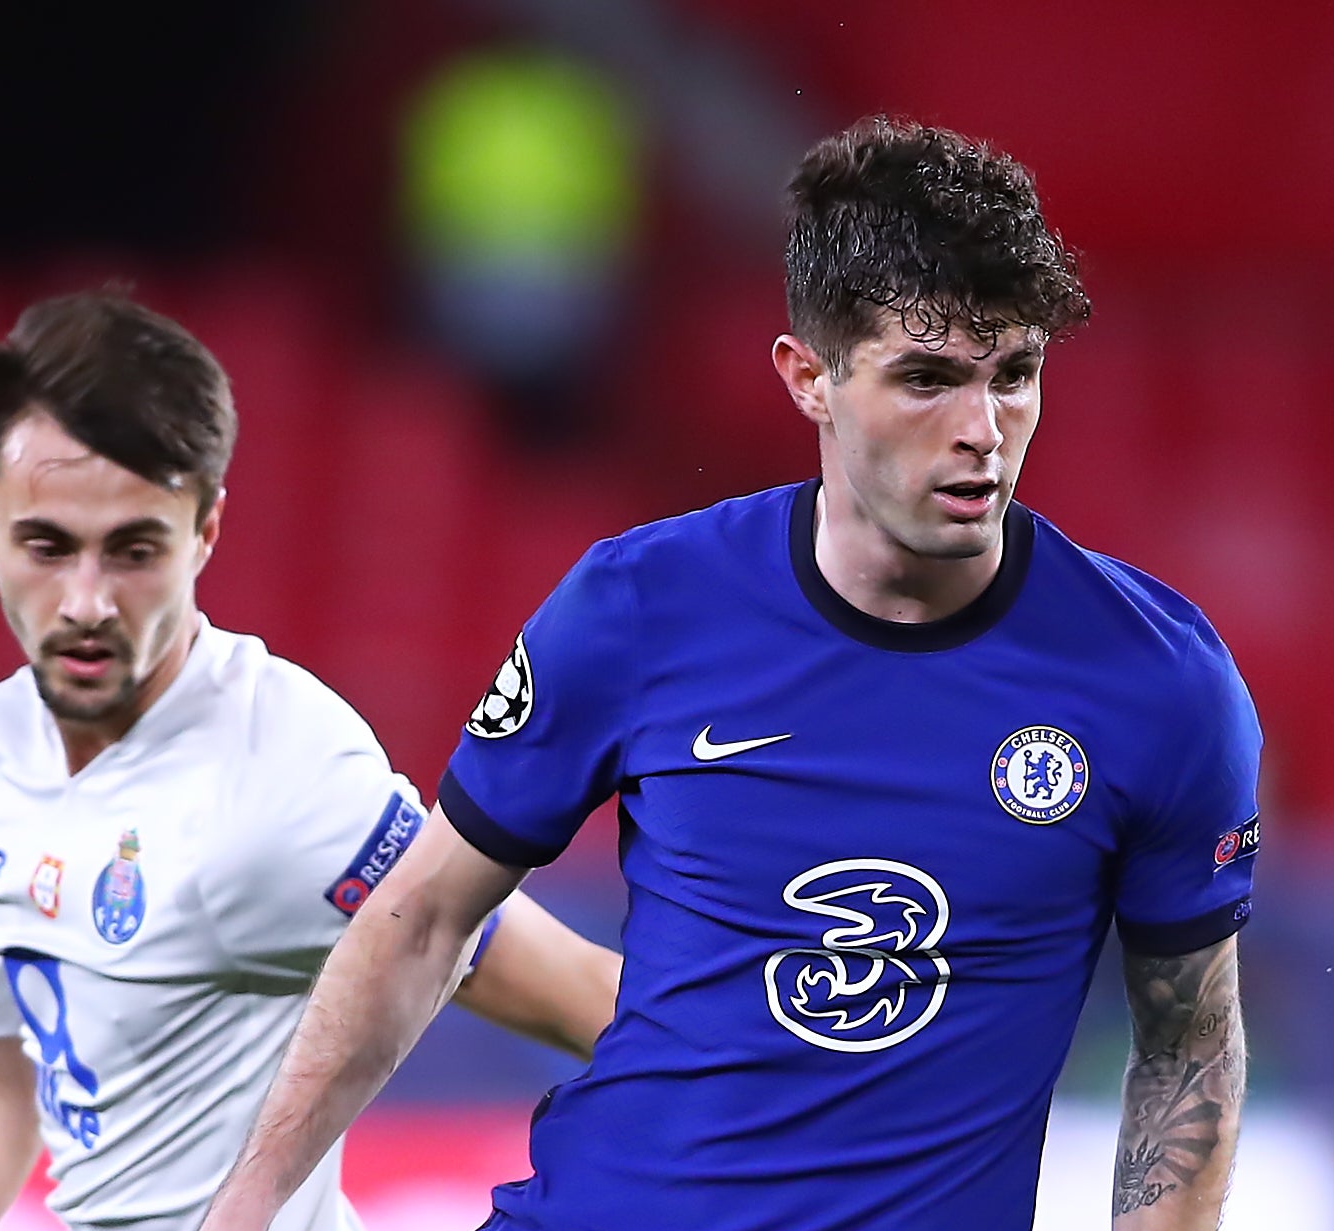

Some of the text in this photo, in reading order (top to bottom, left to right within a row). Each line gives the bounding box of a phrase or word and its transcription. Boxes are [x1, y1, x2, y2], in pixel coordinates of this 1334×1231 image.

[1010, 730, 1073, 754] CHELSEA
[1006, 798, 1070, 819] FOOTBALL CLUB
